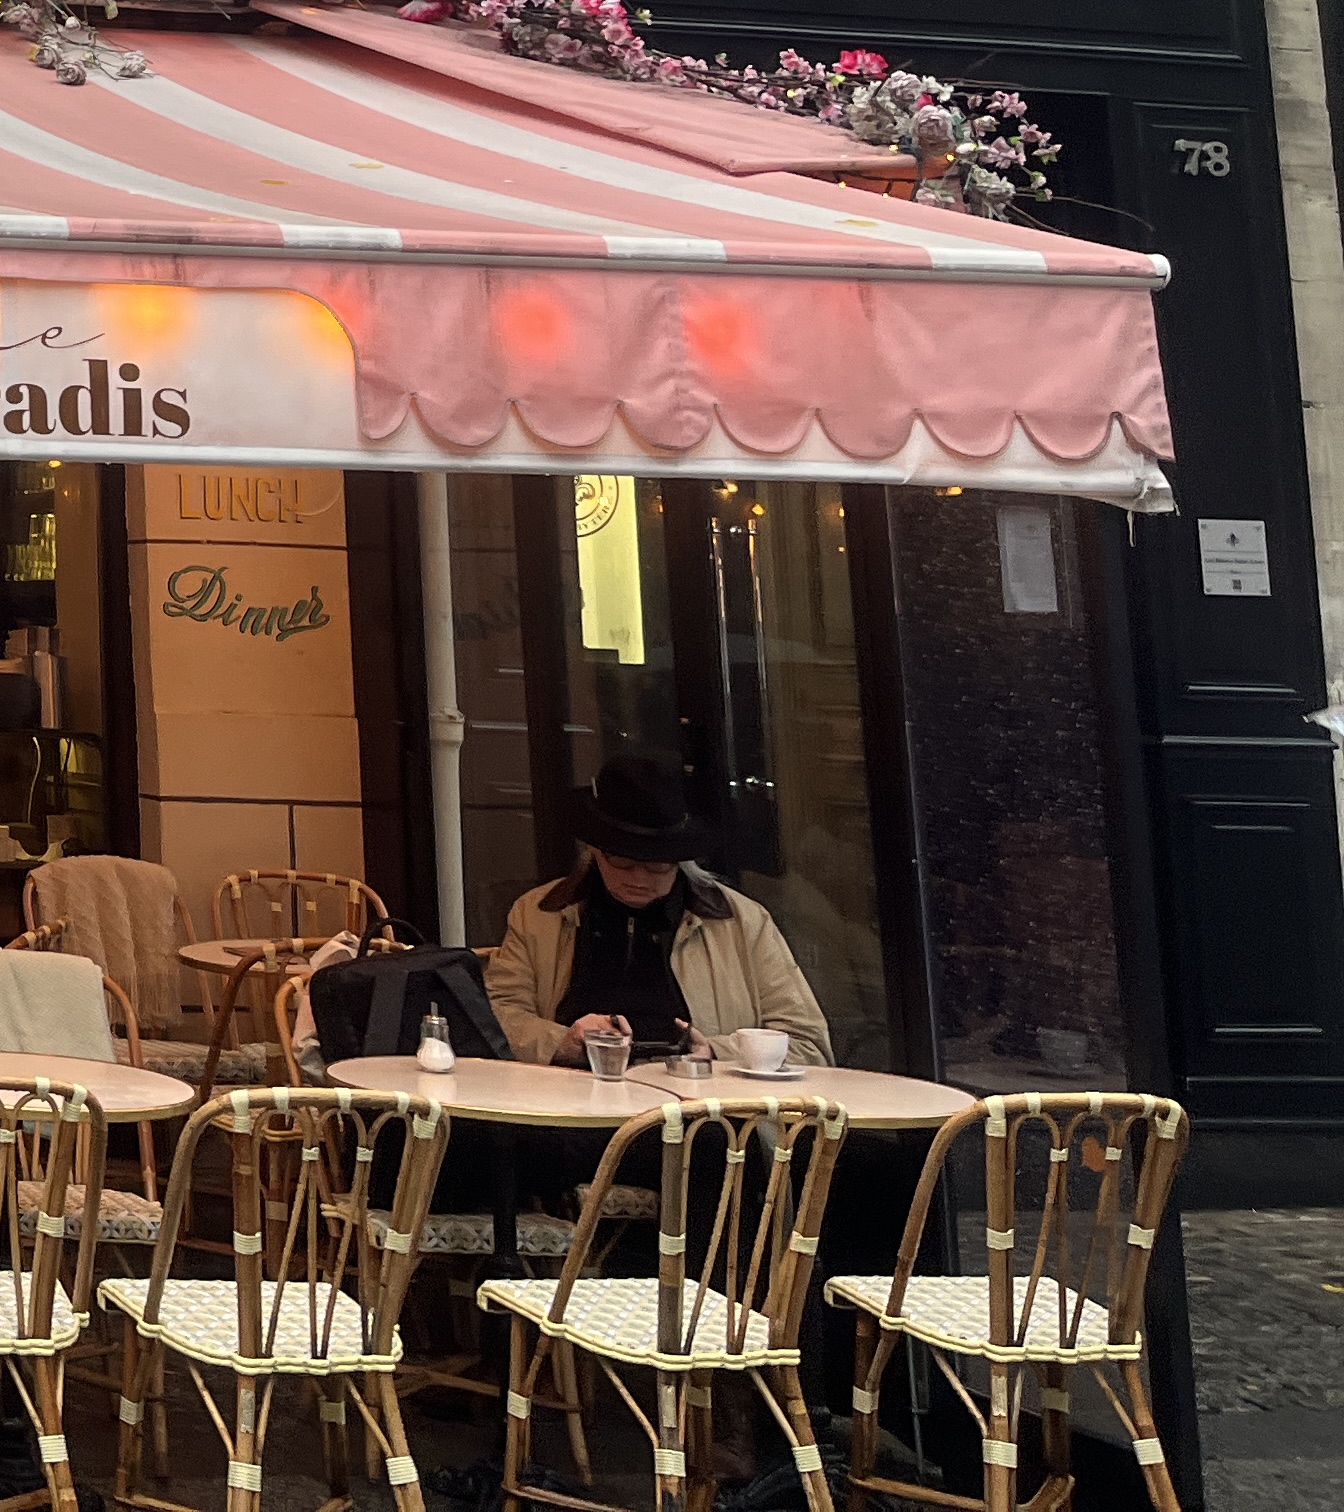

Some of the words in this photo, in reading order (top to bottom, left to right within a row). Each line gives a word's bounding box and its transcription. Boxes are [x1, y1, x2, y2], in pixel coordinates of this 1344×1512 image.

[1173, 138, 1231, 177] 78
[177, 473, 305, 525] LUNCH
[162, 564, 331, 642] Dinner
